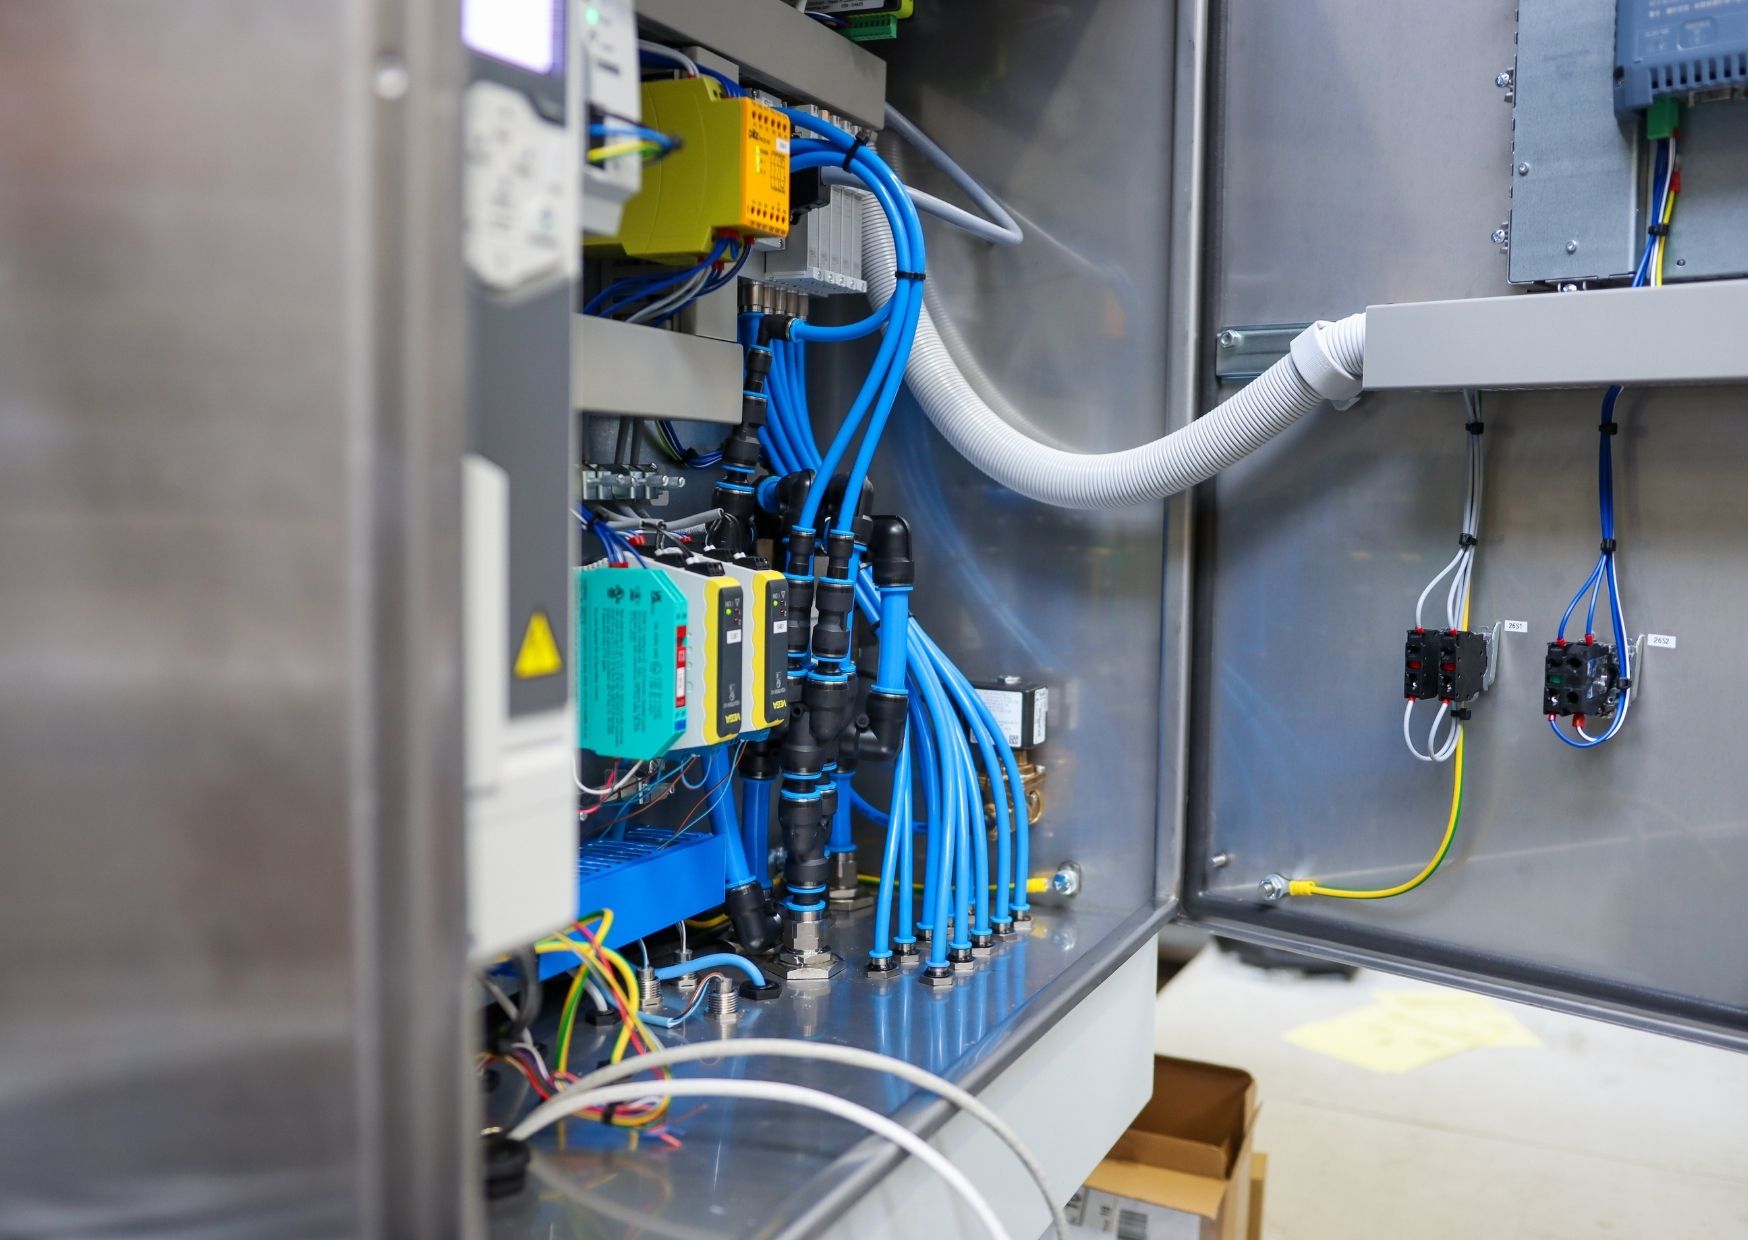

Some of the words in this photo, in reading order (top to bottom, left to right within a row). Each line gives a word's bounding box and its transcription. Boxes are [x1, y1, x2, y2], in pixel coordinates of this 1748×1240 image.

[1508, 622, 1522, 630] 26S1
[1653, 637, 1669, 645] 26S2
[772, 699, 786, 709] VEGA
[725, 713, 740, 723] VEGA
